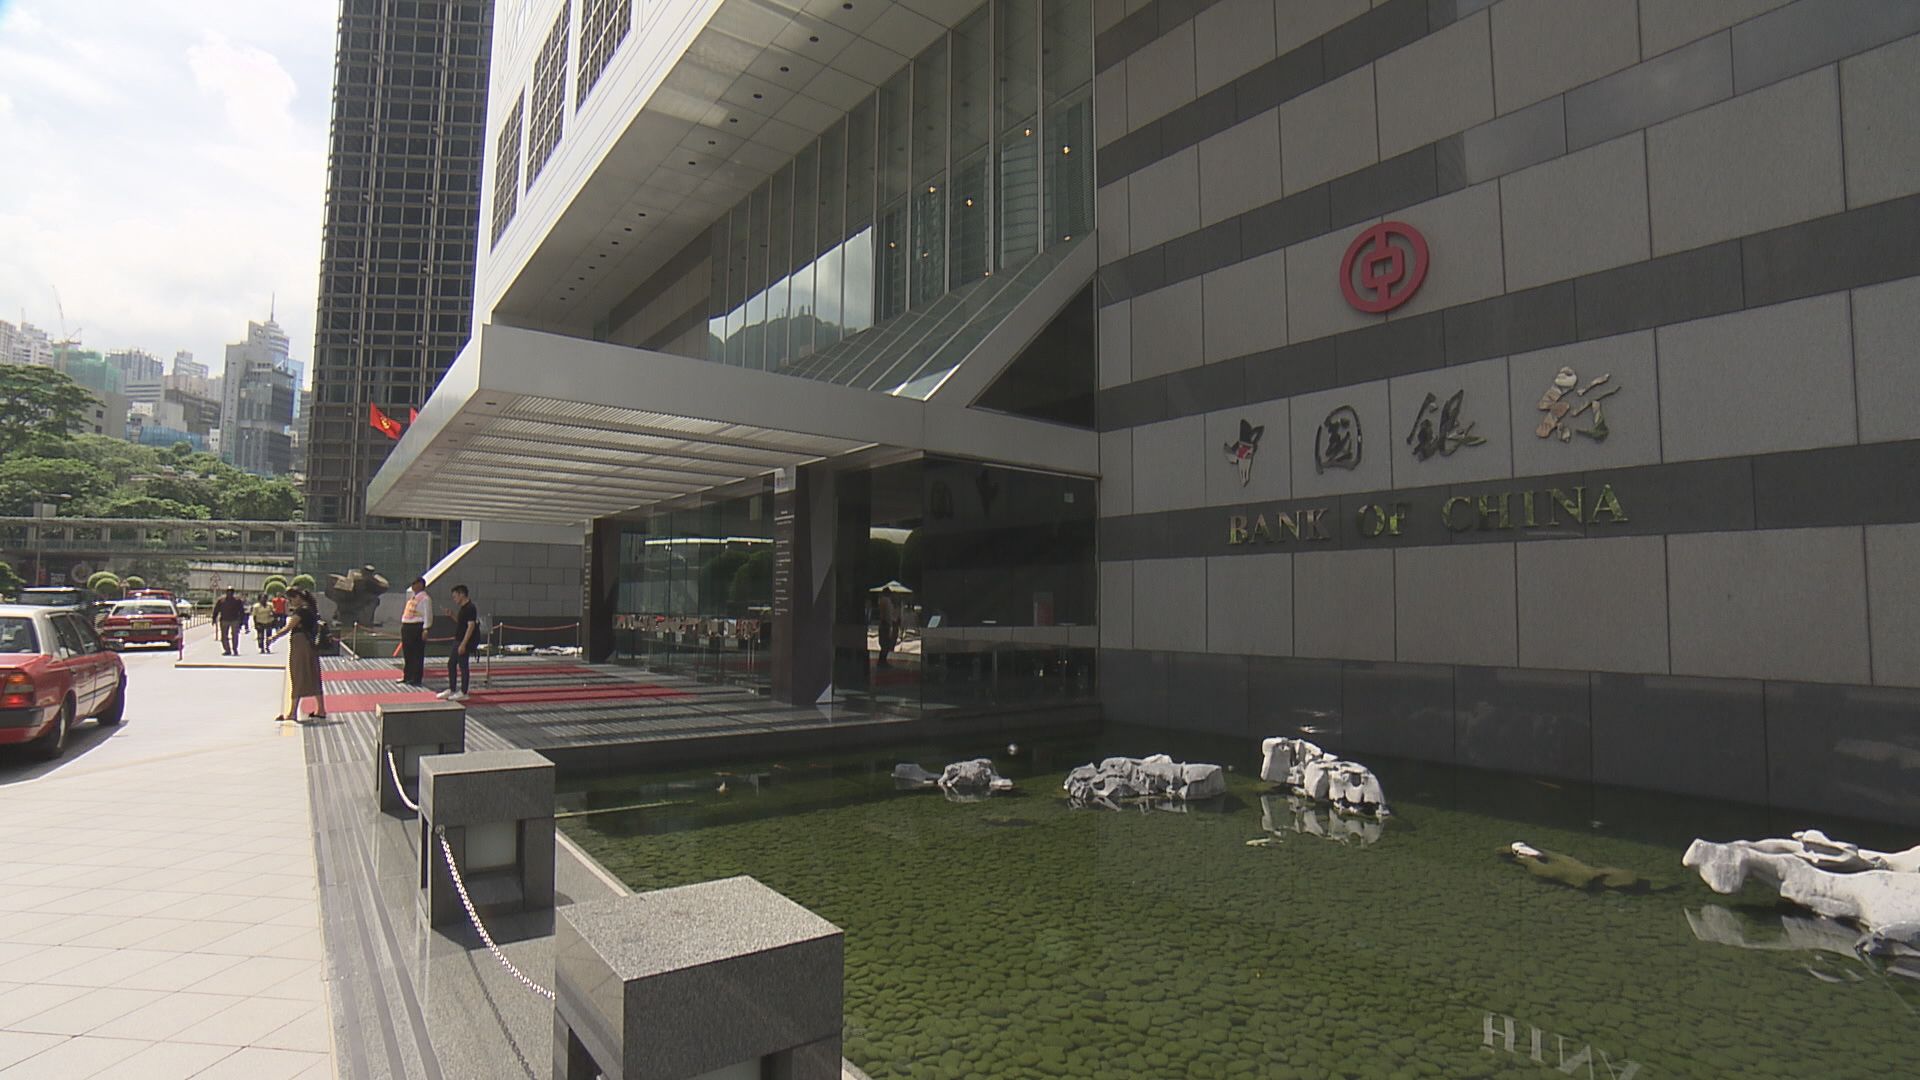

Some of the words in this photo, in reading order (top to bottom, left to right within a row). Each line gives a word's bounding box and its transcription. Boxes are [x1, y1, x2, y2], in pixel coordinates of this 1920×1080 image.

[1227, 507, 1331, 545] BANK
[1357, 502, 1408, 537] OF
[1441, 484, 1631, 533] CHINA
